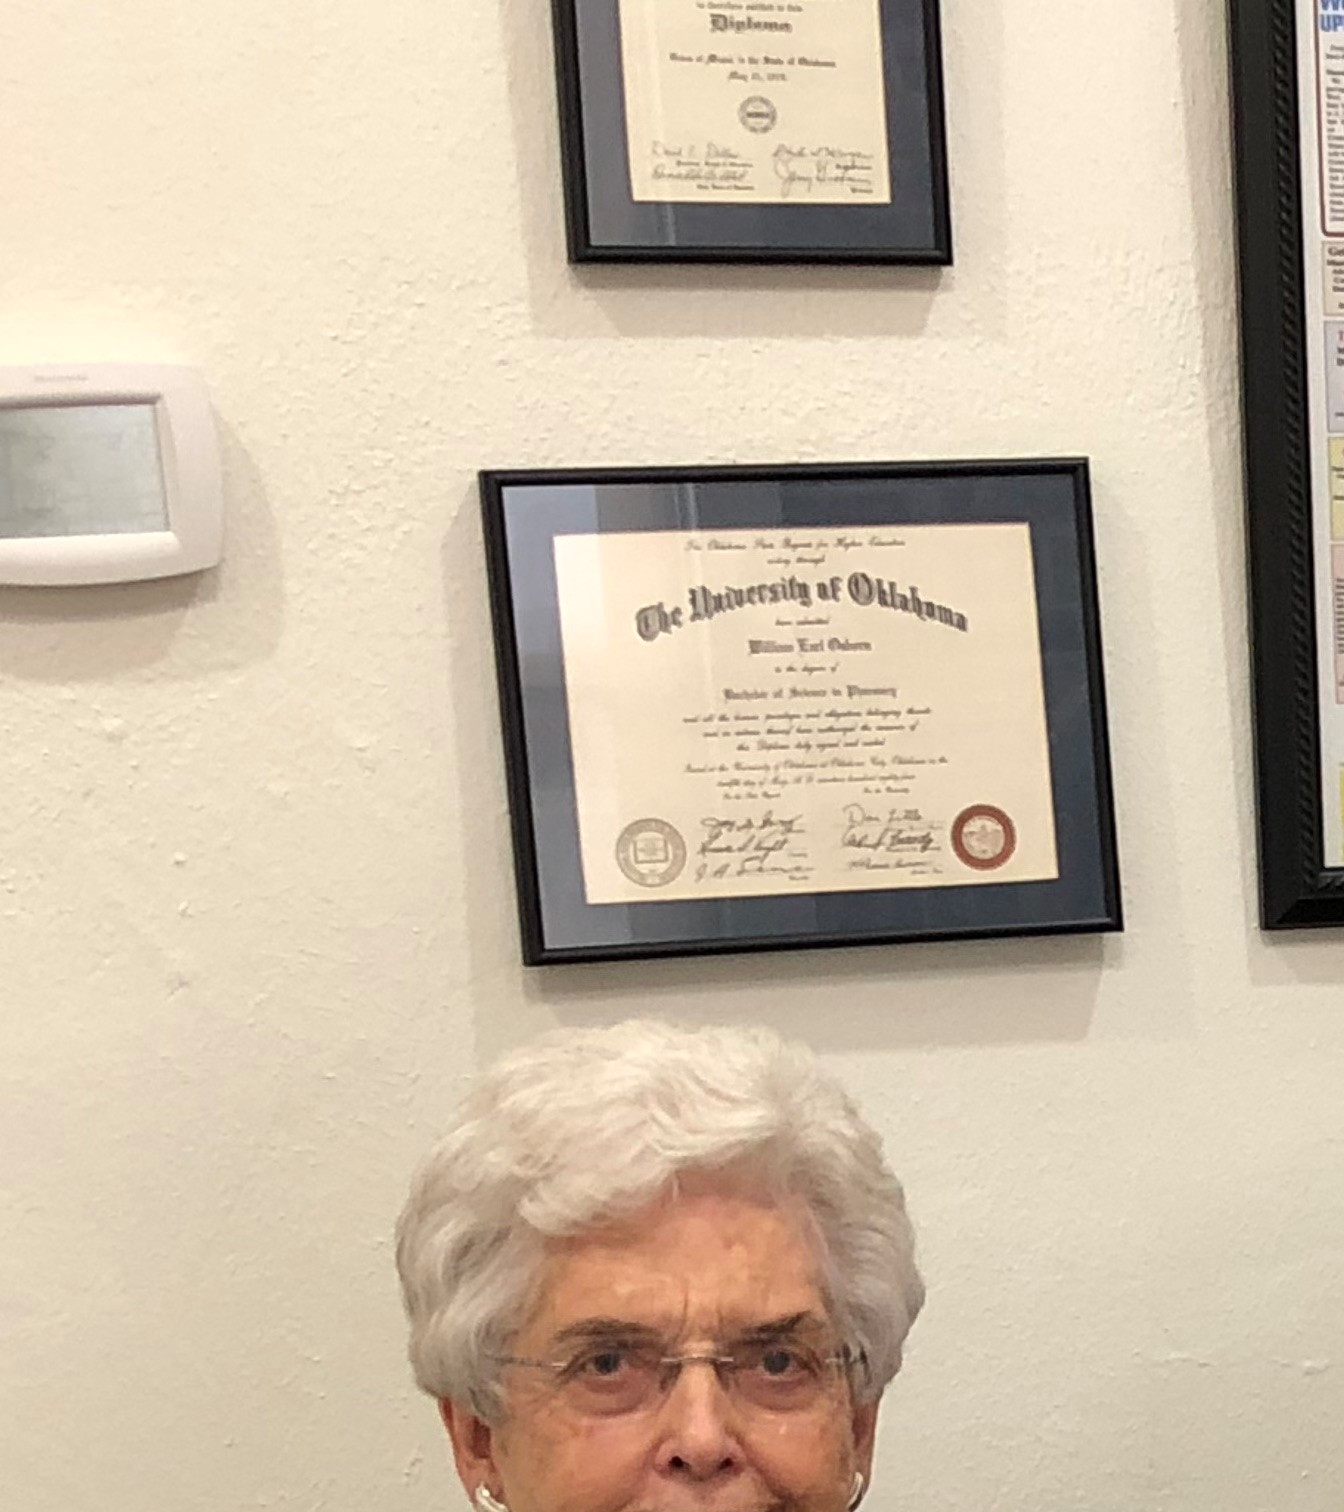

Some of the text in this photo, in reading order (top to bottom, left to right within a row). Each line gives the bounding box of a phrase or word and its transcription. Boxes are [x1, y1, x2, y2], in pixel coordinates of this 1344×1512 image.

[709, 13, 793, 33] Diploma
[635, 571, 968, 642] The University of Oklahoma
